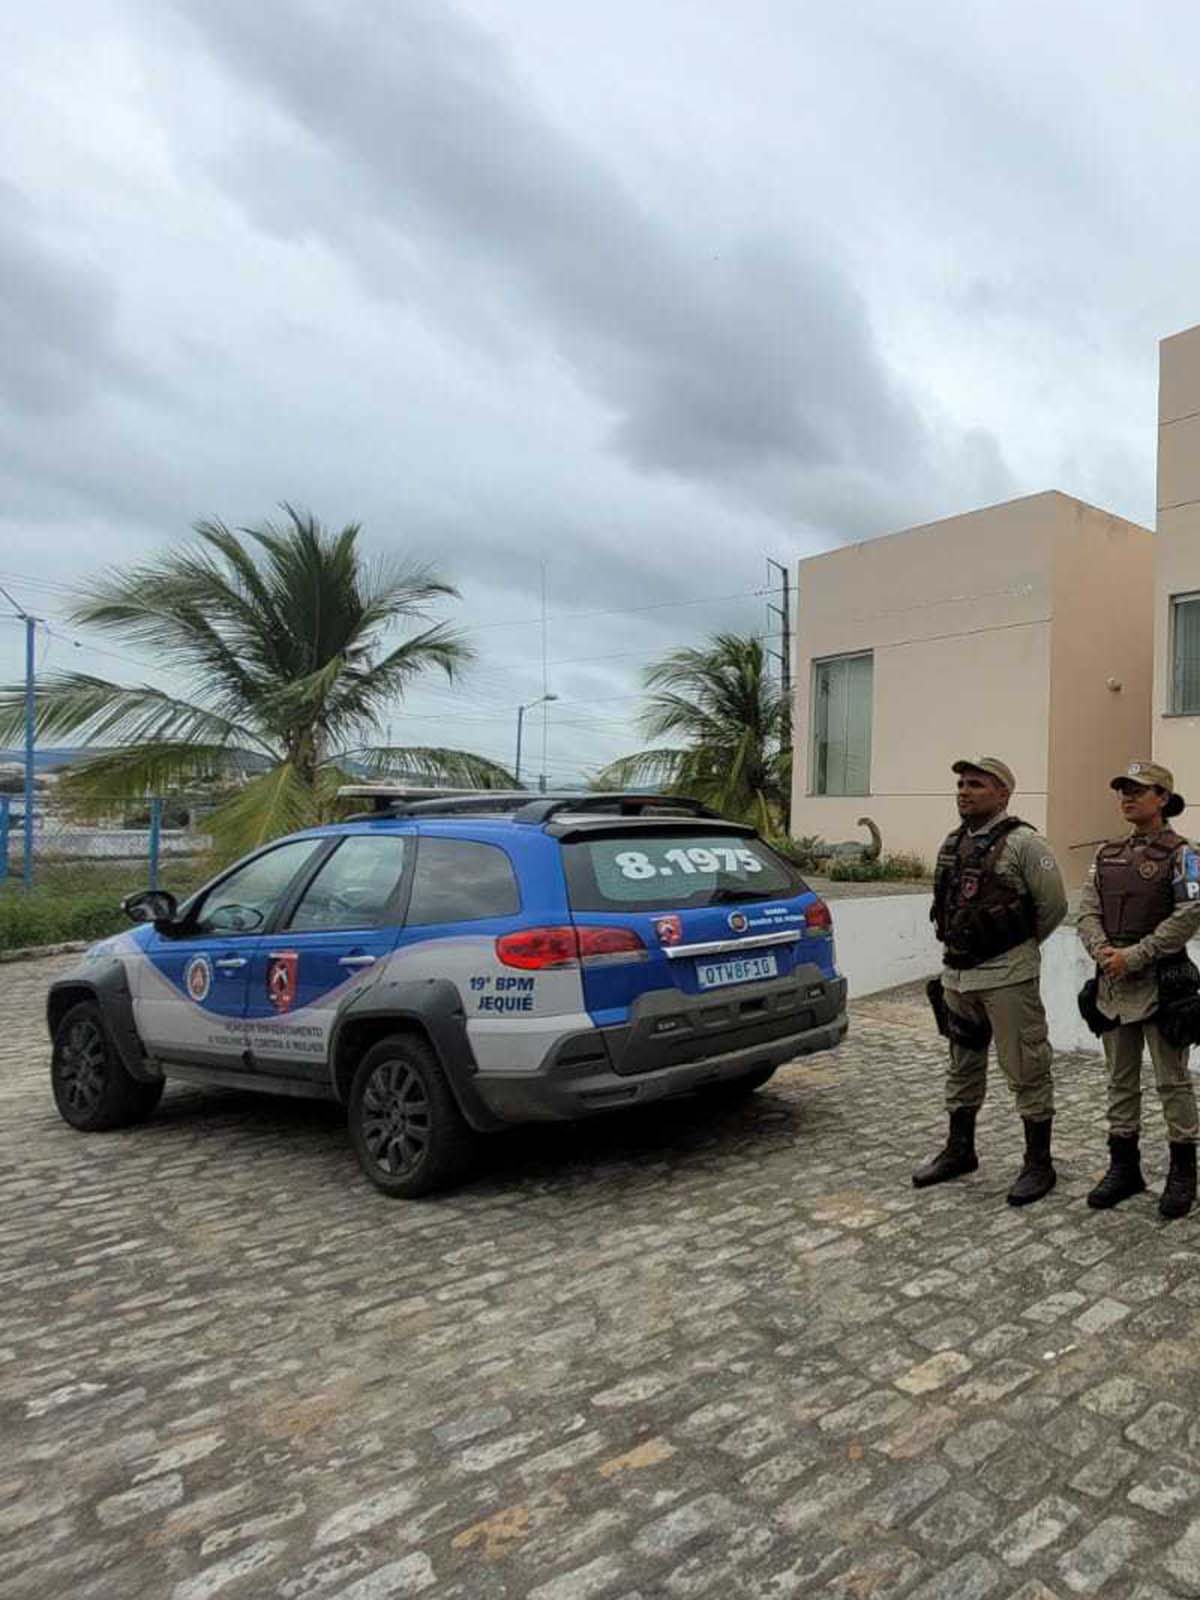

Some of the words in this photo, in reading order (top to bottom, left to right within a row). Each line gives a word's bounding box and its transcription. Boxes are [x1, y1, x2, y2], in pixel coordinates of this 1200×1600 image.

[615, 848, 762, 879] 8.1975
[495, 976, 535, 991] BPM
[478, 993, 534, 1013] JEQUIÉ
